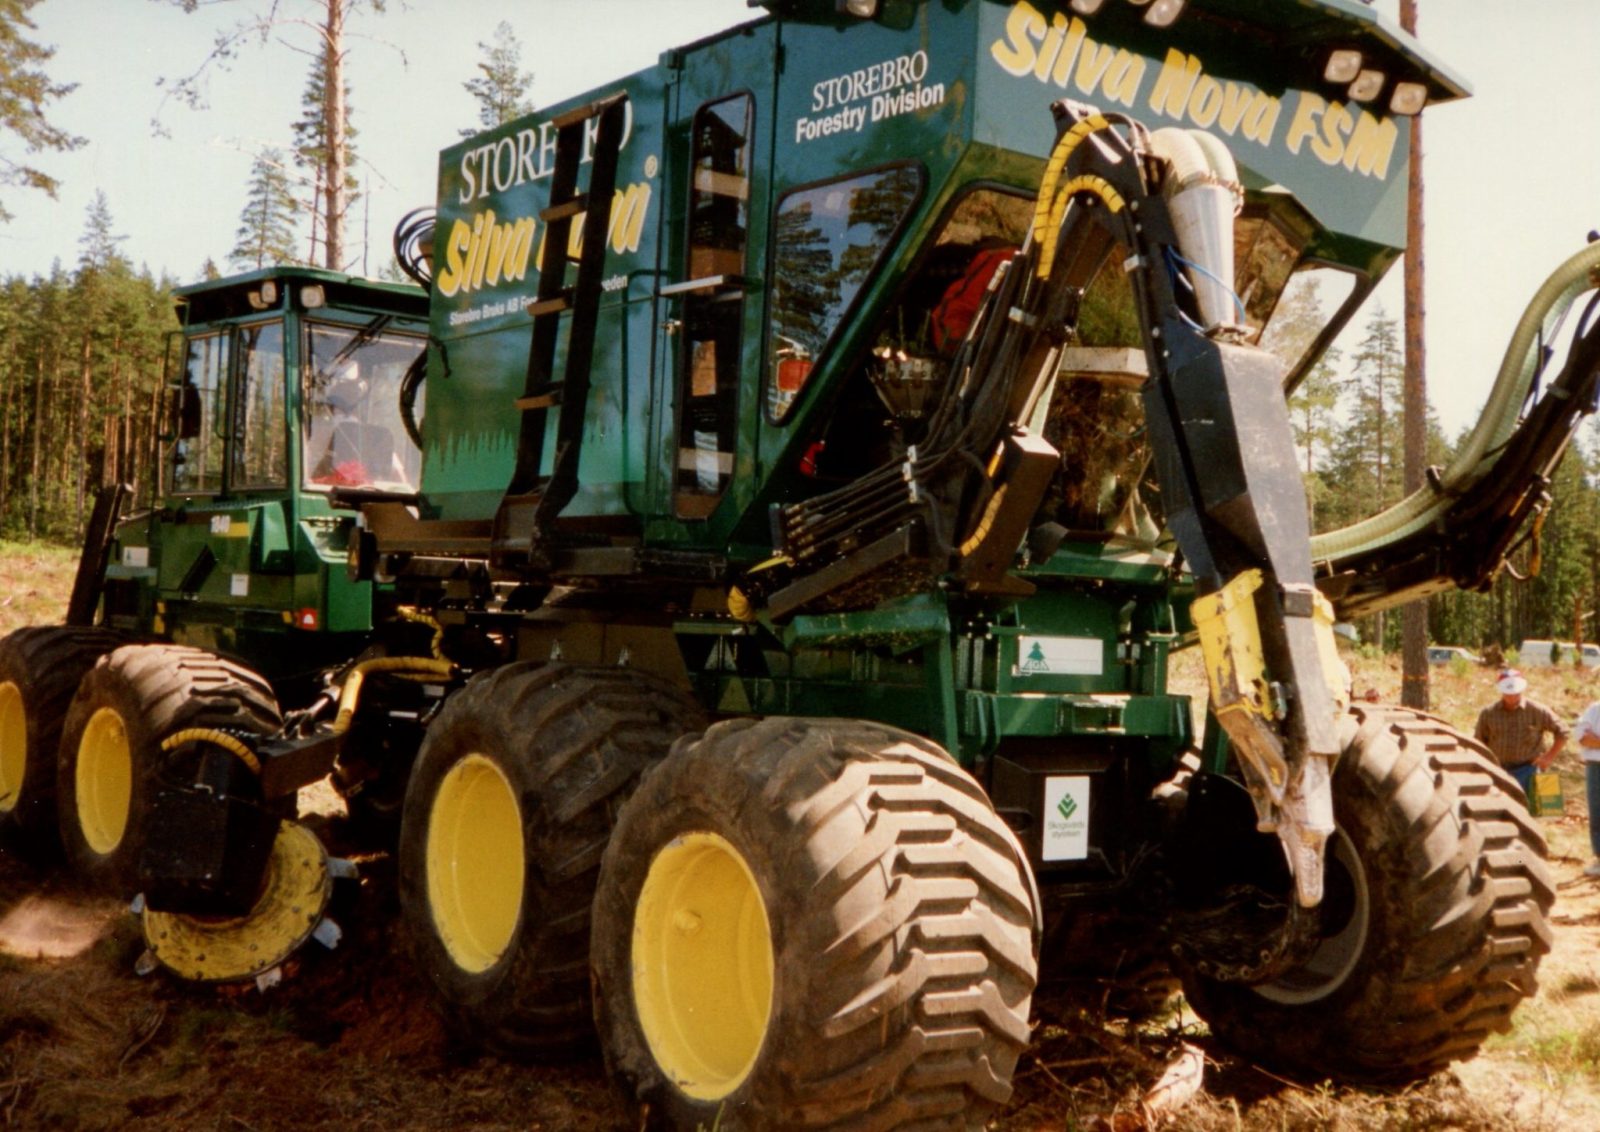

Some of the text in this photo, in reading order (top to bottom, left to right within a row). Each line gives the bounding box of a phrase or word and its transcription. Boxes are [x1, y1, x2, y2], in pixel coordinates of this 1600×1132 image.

[795, 83, 944, 143] Forestry Division
[812, 50, 928, 112] STOREBRO
[991, 0, 1398, 180] Silva Nova FSM
[459, 100, 632, 204] STORER
[437, 209, 535, 297] Silva
